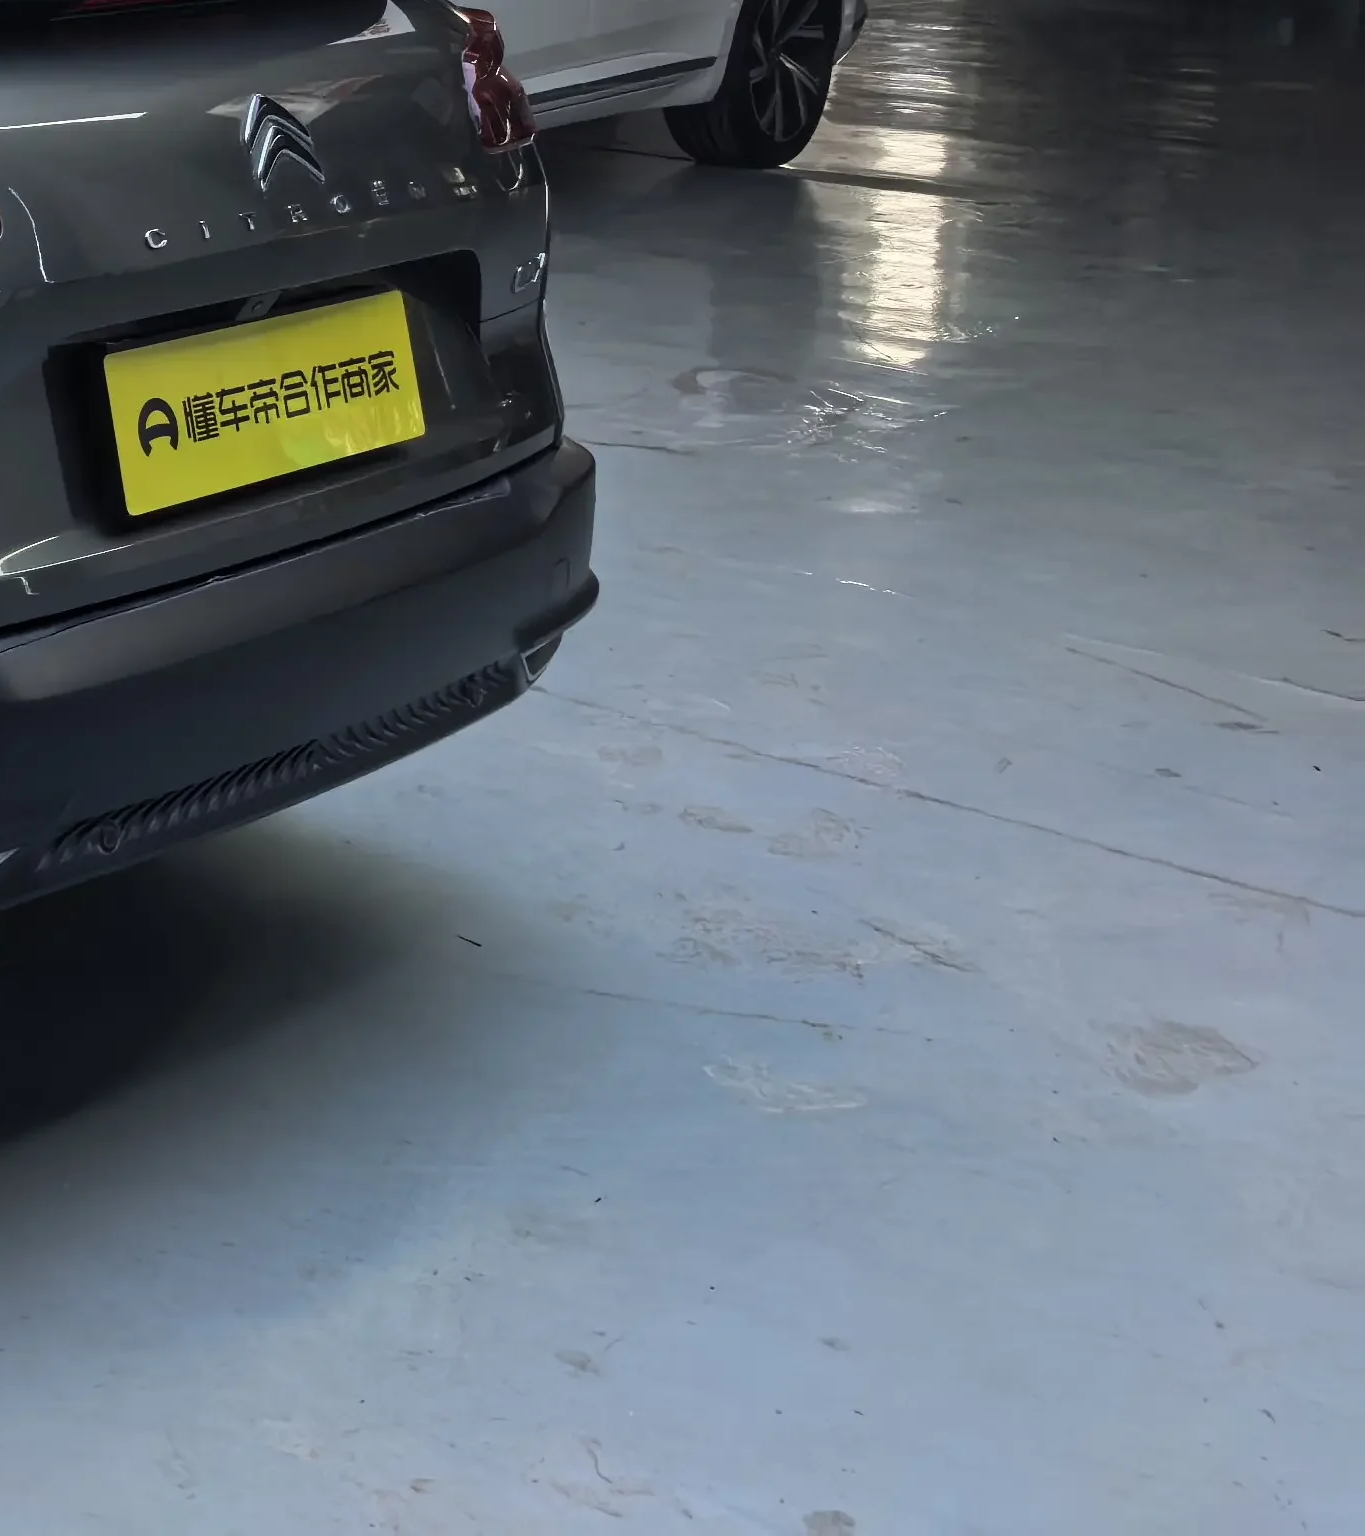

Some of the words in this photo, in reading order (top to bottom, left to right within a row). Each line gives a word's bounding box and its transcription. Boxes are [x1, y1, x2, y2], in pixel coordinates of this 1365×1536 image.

[182, 350, 400, 443] 懂车帝合作商家
